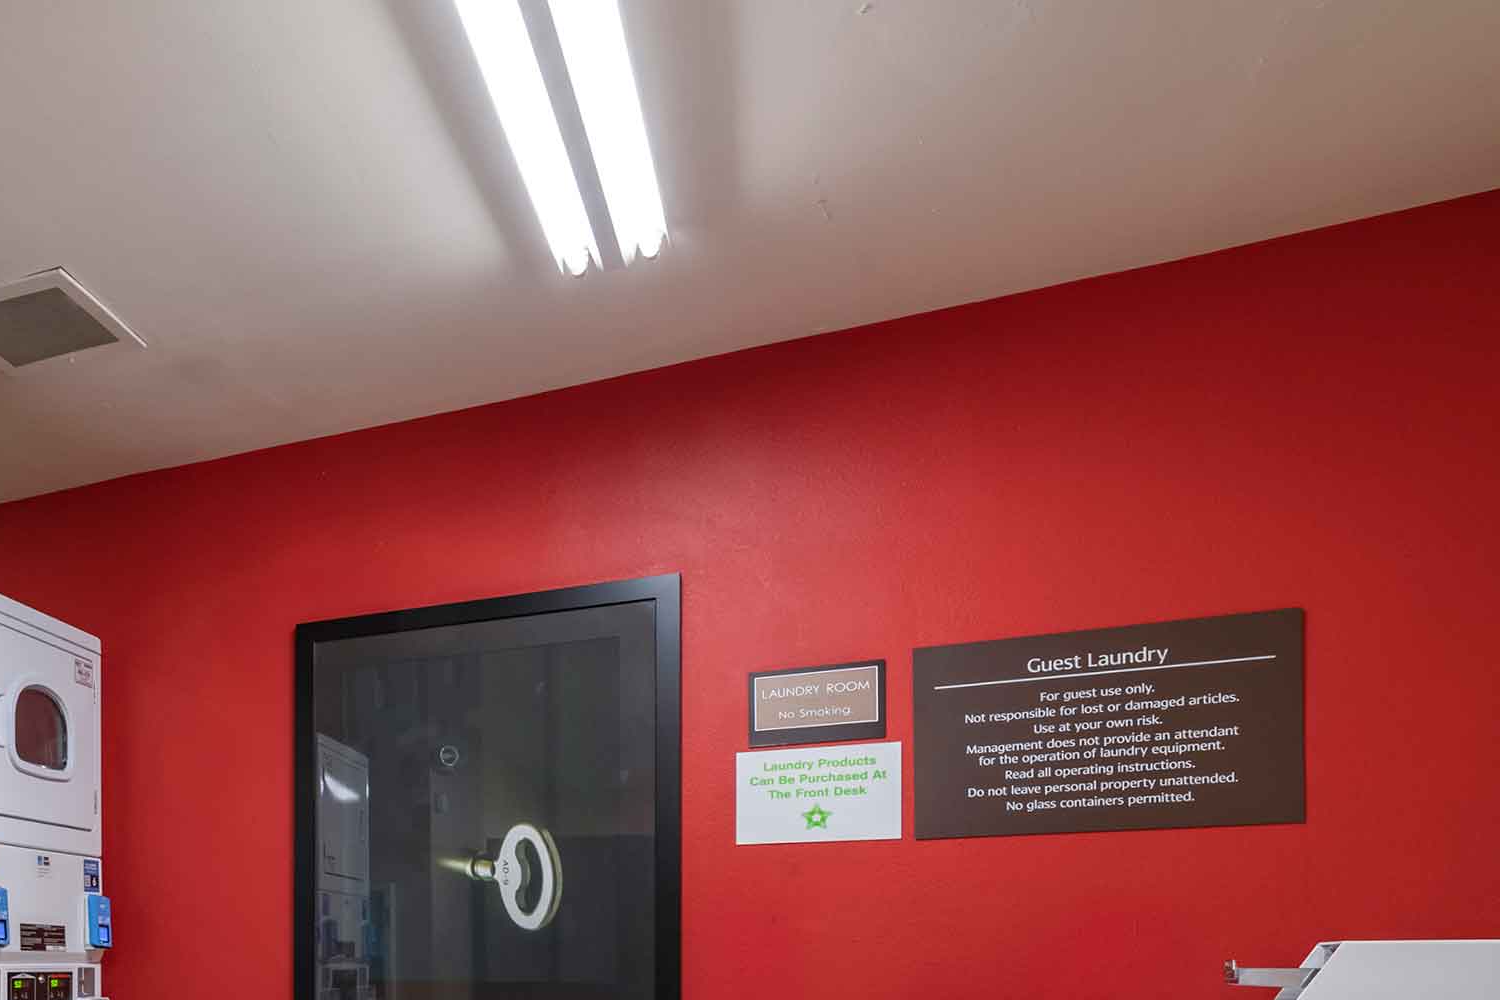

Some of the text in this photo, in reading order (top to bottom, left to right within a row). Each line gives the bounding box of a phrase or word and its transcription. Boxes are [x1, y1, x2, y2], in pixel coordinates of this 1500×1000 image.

[1027, 646, 1169, 673] Guest Laundry
[762, 680, 870, 700] LAUNDRY ROOM
[1040, 682, 1156, 703] For guest use only.
[778, 705, 852, 720] No Smoking
[964, 692, 1240, 724] Not responsible for lost or damaged articles.
[1034, 715, 1163, 734] Use at your own risk.
[966, 725, 1240, 755] Management does not provide an attendant
[979, 740, 1225, 766] for the operation of laundry equipment.
[763, 756, 877, 773] Laundry Products
[1005, 758, 1196, 780] Read all operating instructions.
[749, 768, 887, 786] Can Be Purchased At
[967, 771, 1239, 798] Do not leave personal property unattended.
[769, 784, 867, 800] The Front Desk
[1006, 791, 1196, 813] No glass containers permitted.
[92, 875, 97, 886] 6
